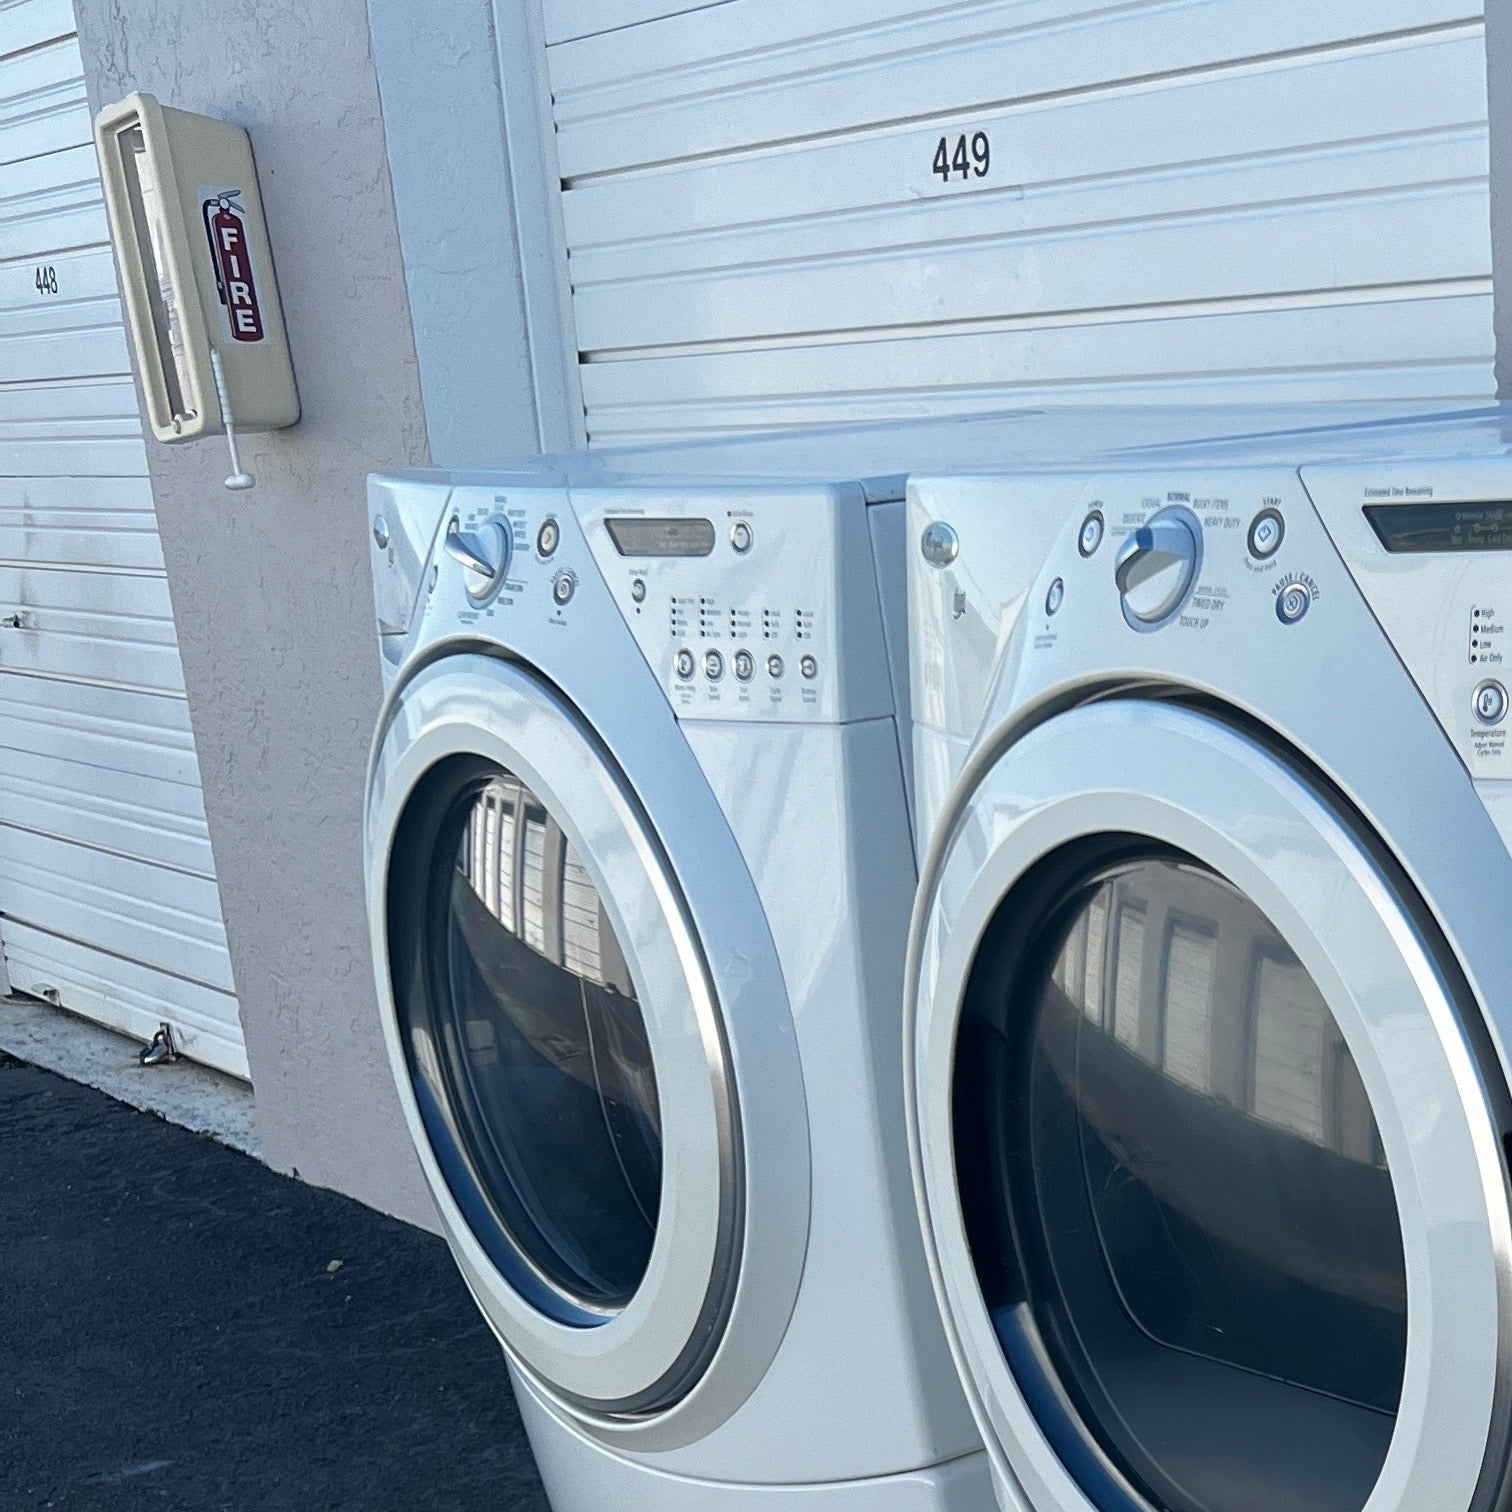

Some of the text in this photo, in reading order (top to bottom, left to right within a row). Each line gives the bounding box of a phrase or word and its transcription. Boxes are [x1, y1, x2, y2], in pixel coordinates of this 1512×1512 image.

[932, 131, 990, 182] 449
[36, 266, 58, 295] 448
[220, 227, 257, 333] FIRE
[1167, 491, 1191, 502] NORMAL
[1262, 496, 1282, 508] START
[1203, 516, 1241, 529] HEAVY DUTY
[1210, 599, 1225, 611] DRY
[1481, 608, 1495, 620] High
[1180, 615, 1210, 629] TOUCH UP
[1480, 624, 1504, 634] Medium
[1479, 652, 1503, 664] Air Only
[1470, 729, 1507, 739] Temperature
